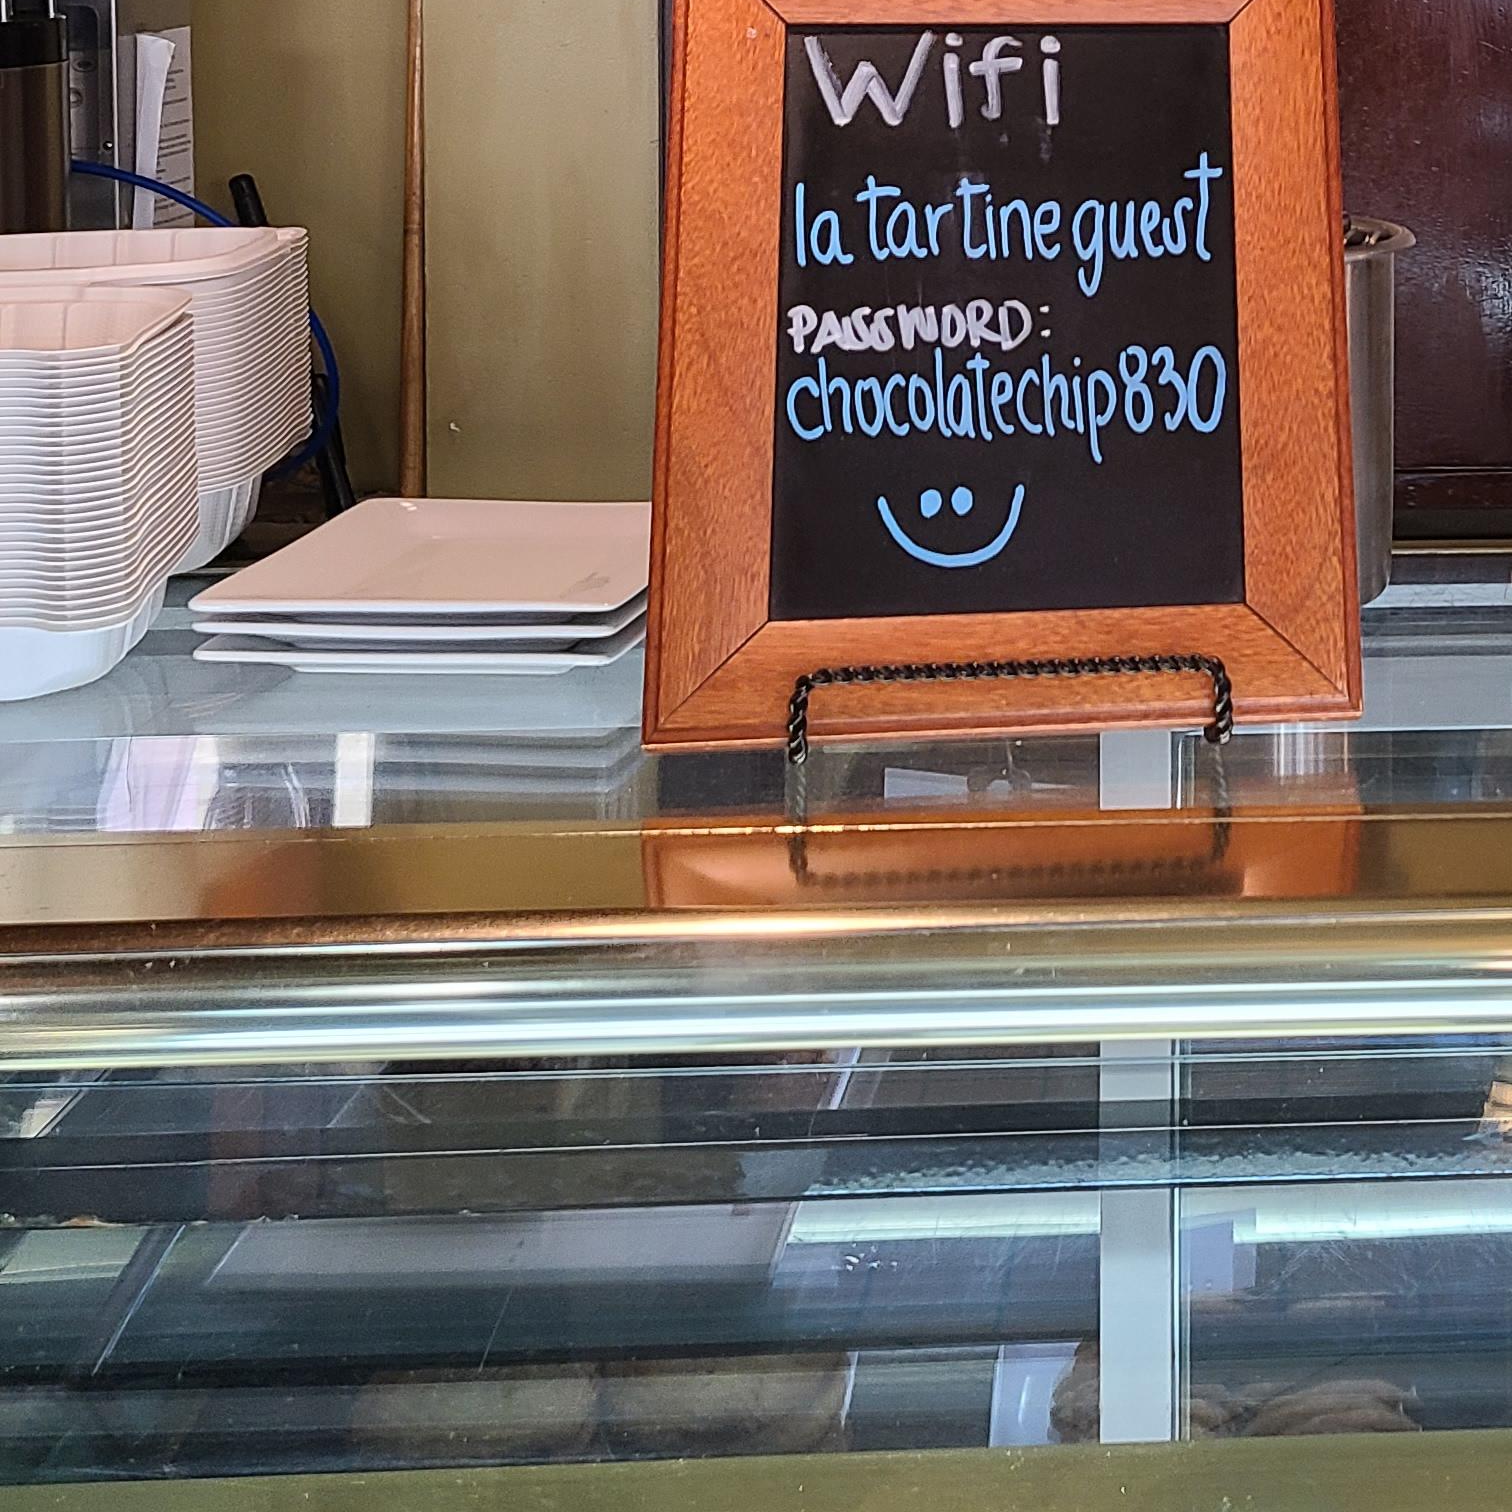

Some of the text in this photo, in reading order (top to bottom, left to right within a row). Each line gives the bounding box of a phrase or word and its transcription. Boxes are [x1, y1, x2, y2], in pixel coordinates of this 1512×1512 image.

[803, 30, 1061, 129] Wifi
[787, 298, 1052, 353] PASSWORD:
[786, 344, 1227, 465] chocolatechip830
